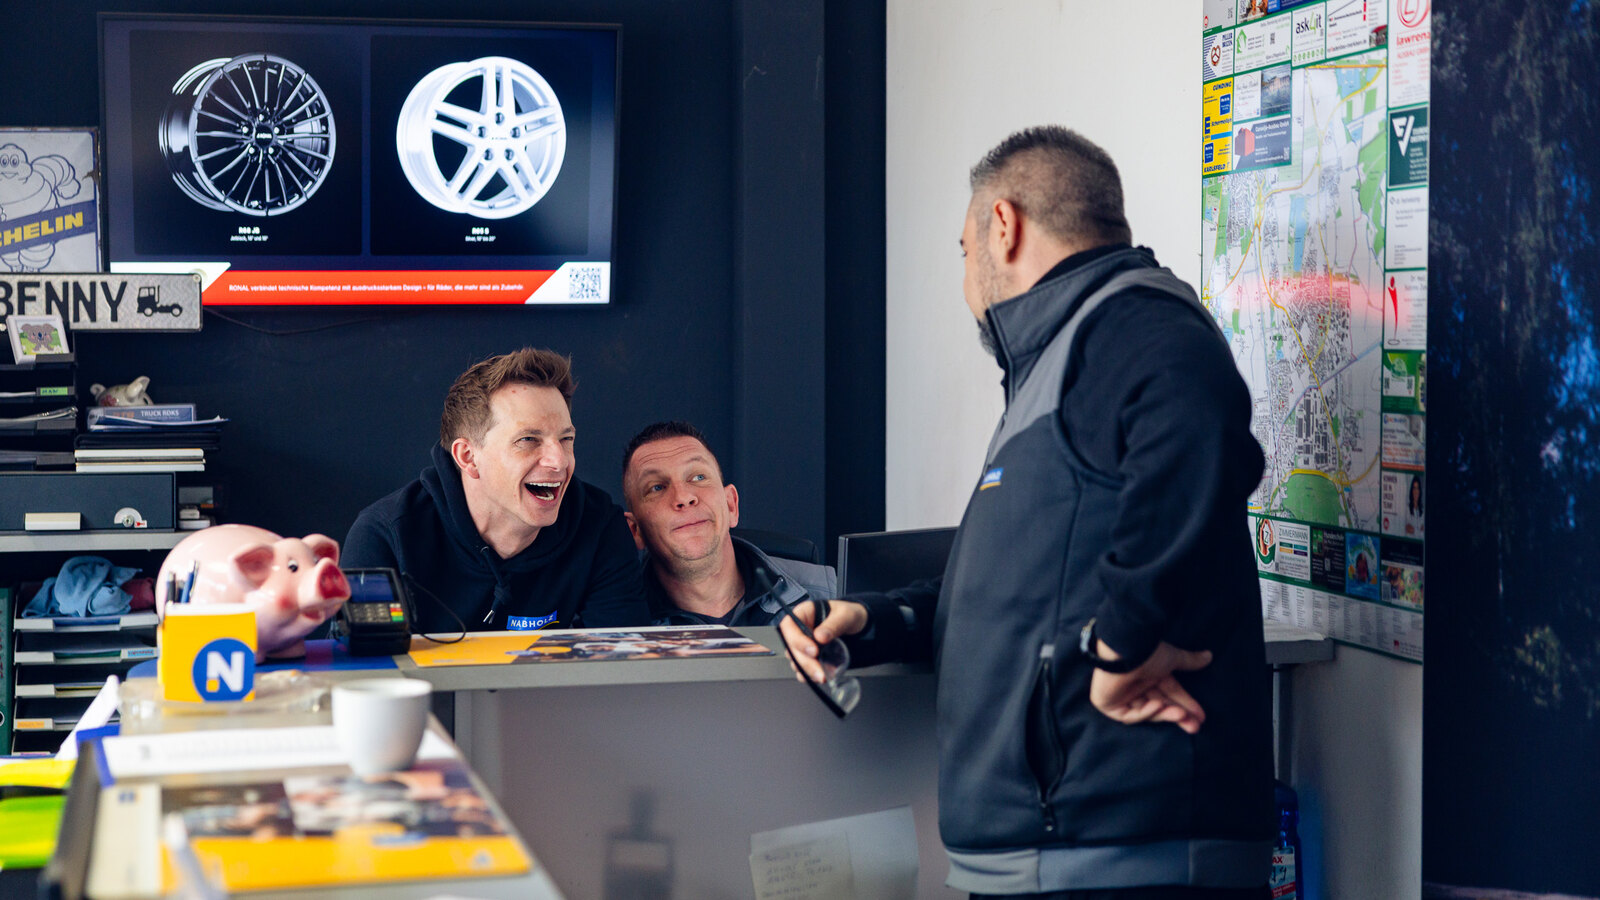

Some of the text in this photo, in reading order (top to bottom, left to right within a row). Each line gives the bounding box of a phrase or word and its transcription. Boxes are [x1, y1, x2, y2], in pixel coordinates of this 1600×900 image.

[1295, 11, 1322, 34] ask4it
[0, 211, 84, 248] HELIN
[310, 284, 341, 292] Kompetenz
[402, 284, 422, 292] Design
[1278, 527, 1308, 540] ZIMMERMANN
[510, 614, 554, 628] NABHOLZ
[206, 651, 245, 692] N
